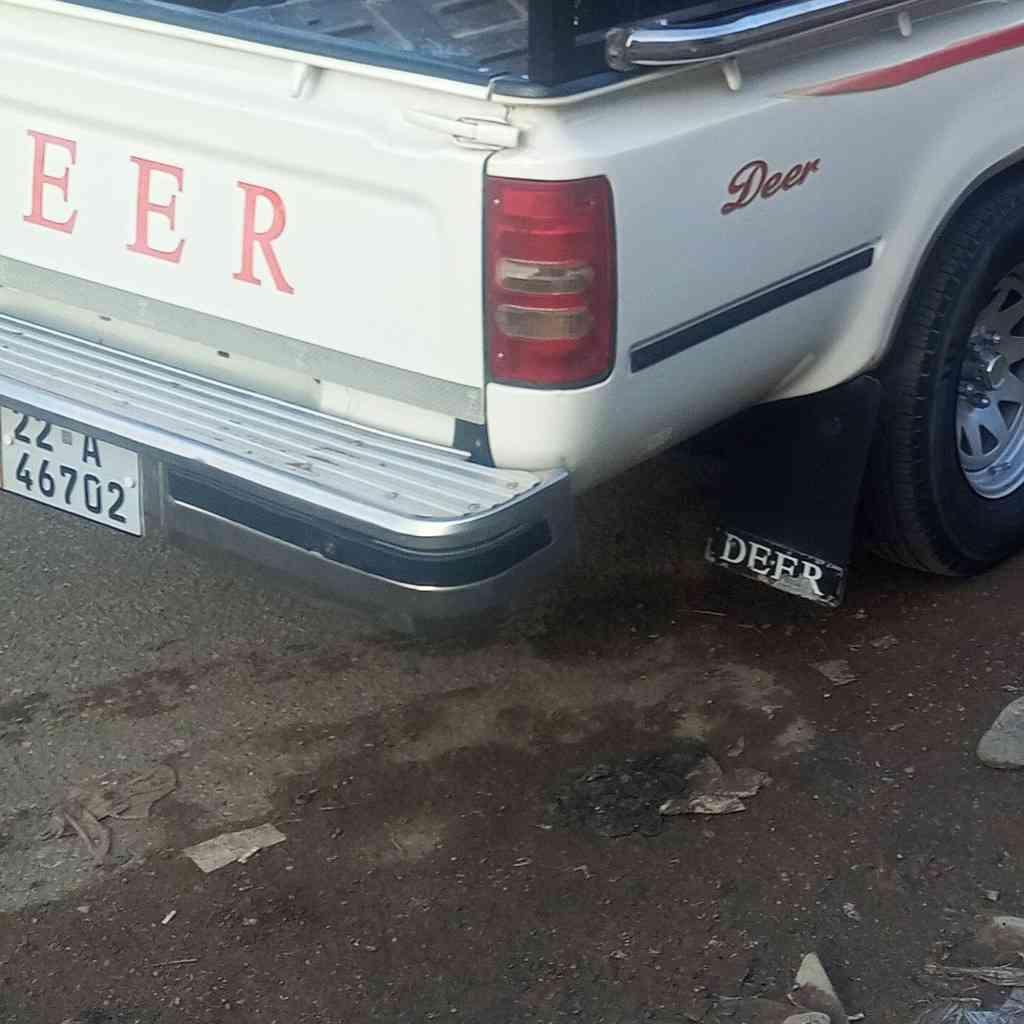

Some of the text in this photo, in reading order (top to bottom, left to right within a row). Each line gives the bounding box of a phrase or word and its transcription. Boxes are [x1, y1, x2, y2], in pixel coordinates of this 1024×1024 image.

[720, 158, 822, 216] Deer
[82, 434, 102, 468] A
[16, 451, 127, 524] 46702
